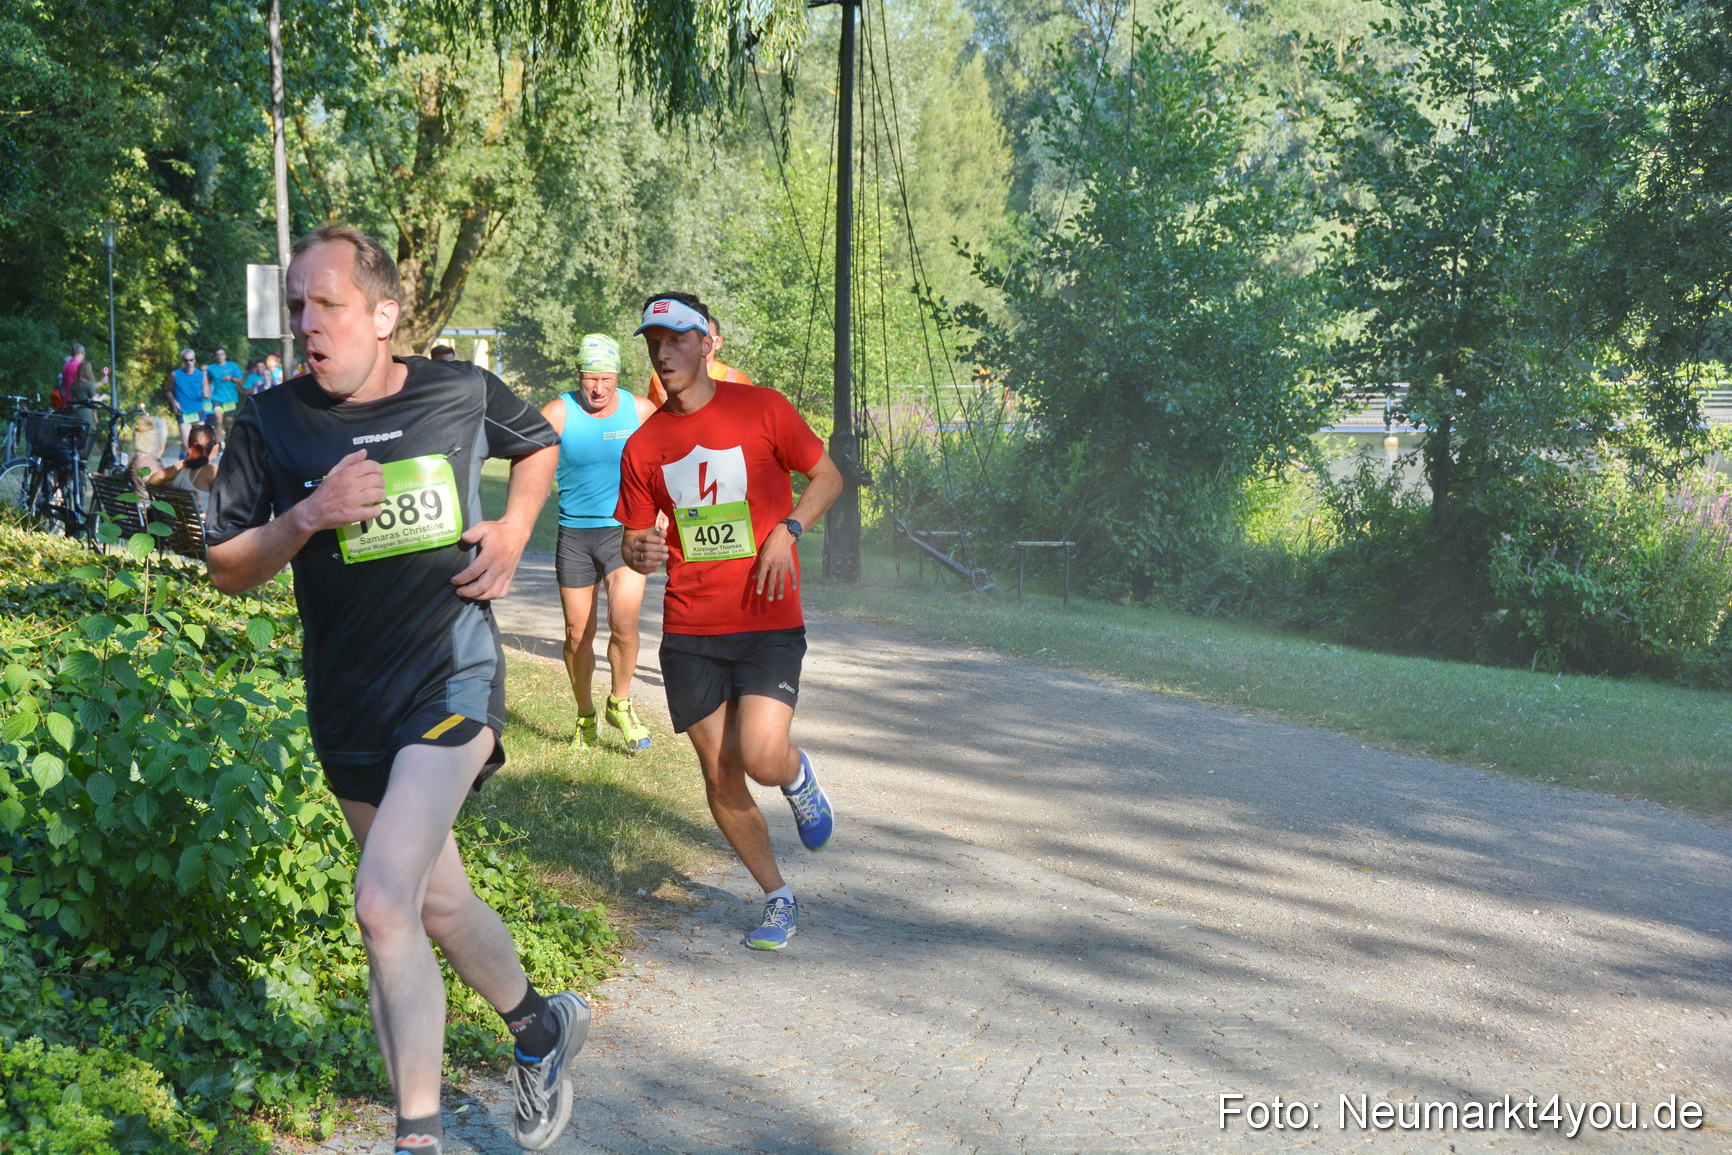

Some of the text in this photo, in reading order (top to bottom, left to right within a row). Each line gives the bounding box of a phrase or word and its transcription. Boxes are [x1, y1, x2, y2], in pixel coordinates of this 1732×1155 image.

[349, 546, 371, 554] Regens
[373, 541, 395, 550] Wagner
[397, 536, 420, 546] Stiftung
[360, 522, 444, 545] Samaras Christine
[694, 523, 736, 546] 402
